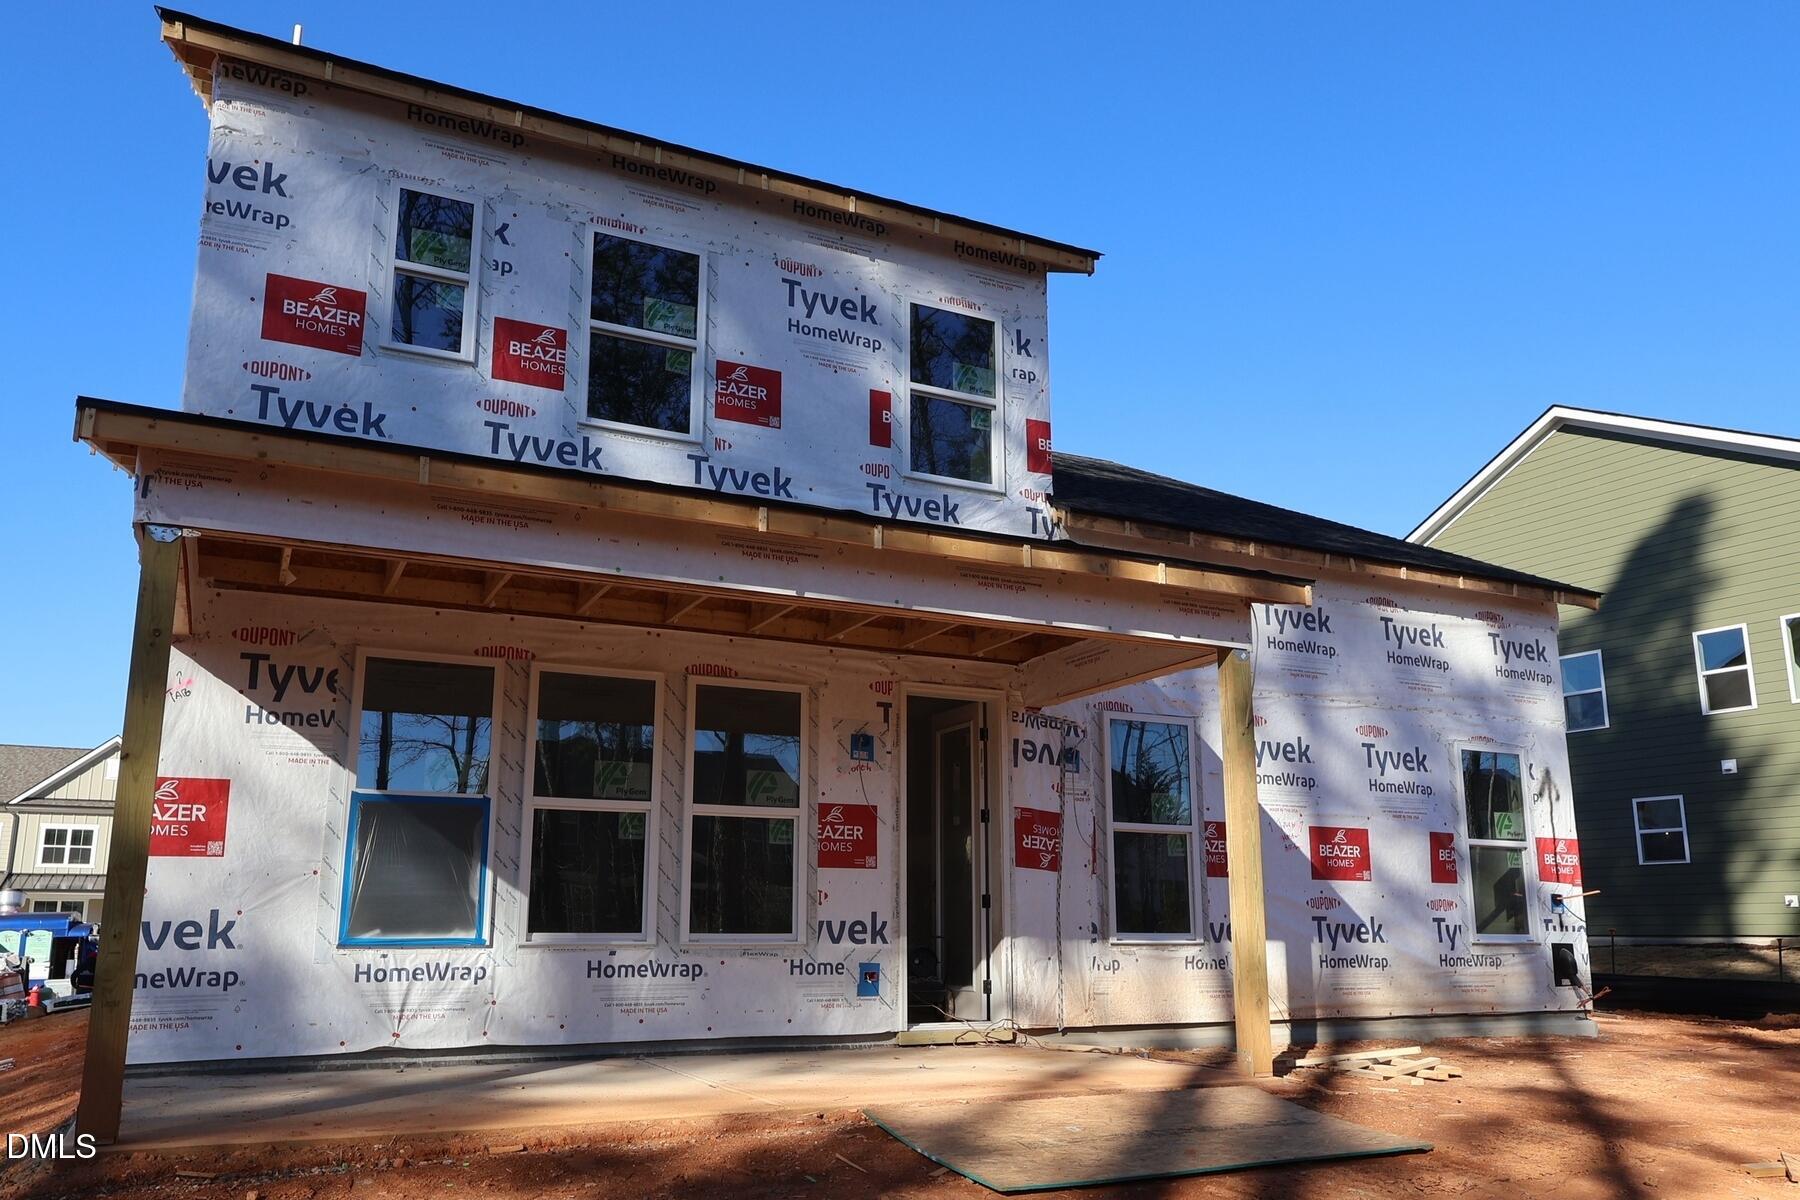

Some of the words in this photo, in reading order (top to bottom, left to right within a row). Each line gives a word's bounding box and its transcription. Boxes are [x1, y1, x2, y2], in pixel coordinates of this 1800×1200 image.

[407, 103, 525, 149] HomeWrap
[612, 154, 716, 194] HomeWrap
[793, 200, 885, 236] HomeWrap
[780, 258, 818, 278] DUPONT
[954, 240, 1037, 274] HomeWrap
[782, 277, 878, 325] Tyvek
[283, 299, 361, 328] BEAZER
[296, 318, 346, 337] HOMES
[788, 318, 882, 352] HomeWrap
[509, 340, 566, 364] BEAZE
[251, 360, 304, 382] DUPONT
[520, 359, 565, 376] HOMES
[715, 380, 767, 400] EAZER
[251, 384, 387, 438] Tyvek
[484, 399, 531, 418] DUPONT
[717, 396, 756, 410] HOMES
[484, 420, 604, 471] Tyvek
[687, 453, 793, 499] Tyvek
[866, 482, 960, 525] Tyvek
[461, 514, 485, 524] MADE
[486, 517, 495, 525] IN
[497, 519, 512, 527] THE
[514, 520, 529, 529] USA
[742, 550, 762, 559] MADE
[772, 553, 785, 562] THE
[785, 555, 799, 563] USA
[1264, 604, 1332, 634] Tyvek
[240, 627, 297, 646] DUPONT
[1380, 616, 1445, 649] Tyvek
[1267, 636, 1336, 659] HomeWrap
[1488, 632, 1549, 664] Tyvek
[1387, 651, 1450, 673] HomeWrap
[1495, 665, 1553, 685] HomeWrap
[1358, 725, 1385, 739] DUPONT
[1361, 742, 1429, 777] Tyvek
[1368, 779, 1433, 798] HomeWrap
[1319, 844, 1361, 858] BEAZER
[1544, 853, 1579, 867] BEAZER
[1327, 858, 1355, 868] HOMES
[1551, 866, 1574, 875] HOMES
[1310, 897, 1338, 911] DUPONT
[1430, 899, 1455, 912] DUPONT
[141, 909, 236, 951] vek
[1312, 915, 1386, 951] Tyvek
[1432, 917, 1462, 951] Ty
[587, 959, 704, 982] HomeWrap
[790, 958, 845, 976] Home
[1184, 955, 1229, 970] Home
[1319, 954, 1388, 972] HomeWrap
[1439, 953, 1502, 969] HomeWrap
[354, 962, 487, 985] HomeWrap
[129, 1023, 148, 1031] MADE
[159, 1022, 174, 1030] THE
